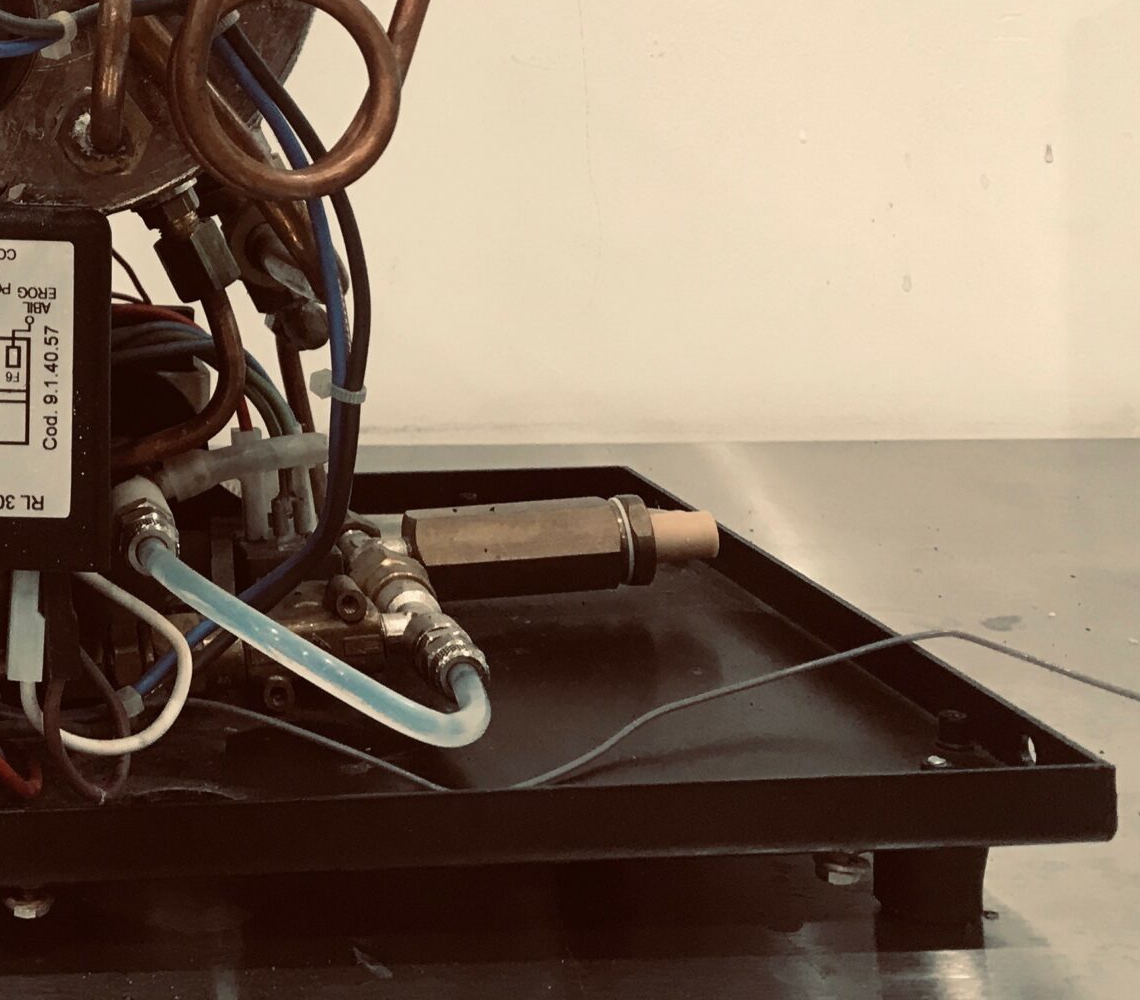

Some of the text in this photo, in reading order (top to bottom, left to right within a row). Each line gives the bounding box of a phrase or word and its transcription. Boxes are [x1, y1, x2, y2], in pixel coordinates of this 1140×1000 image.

[17, 286, 57, 300] EROG
[22, 301, 52, 315] ABIL
[5, 371, 20, 383] F6
[42, 325, 59, 451] Cod. 9.1.40.57
[20, 494, 45, 511] RL
